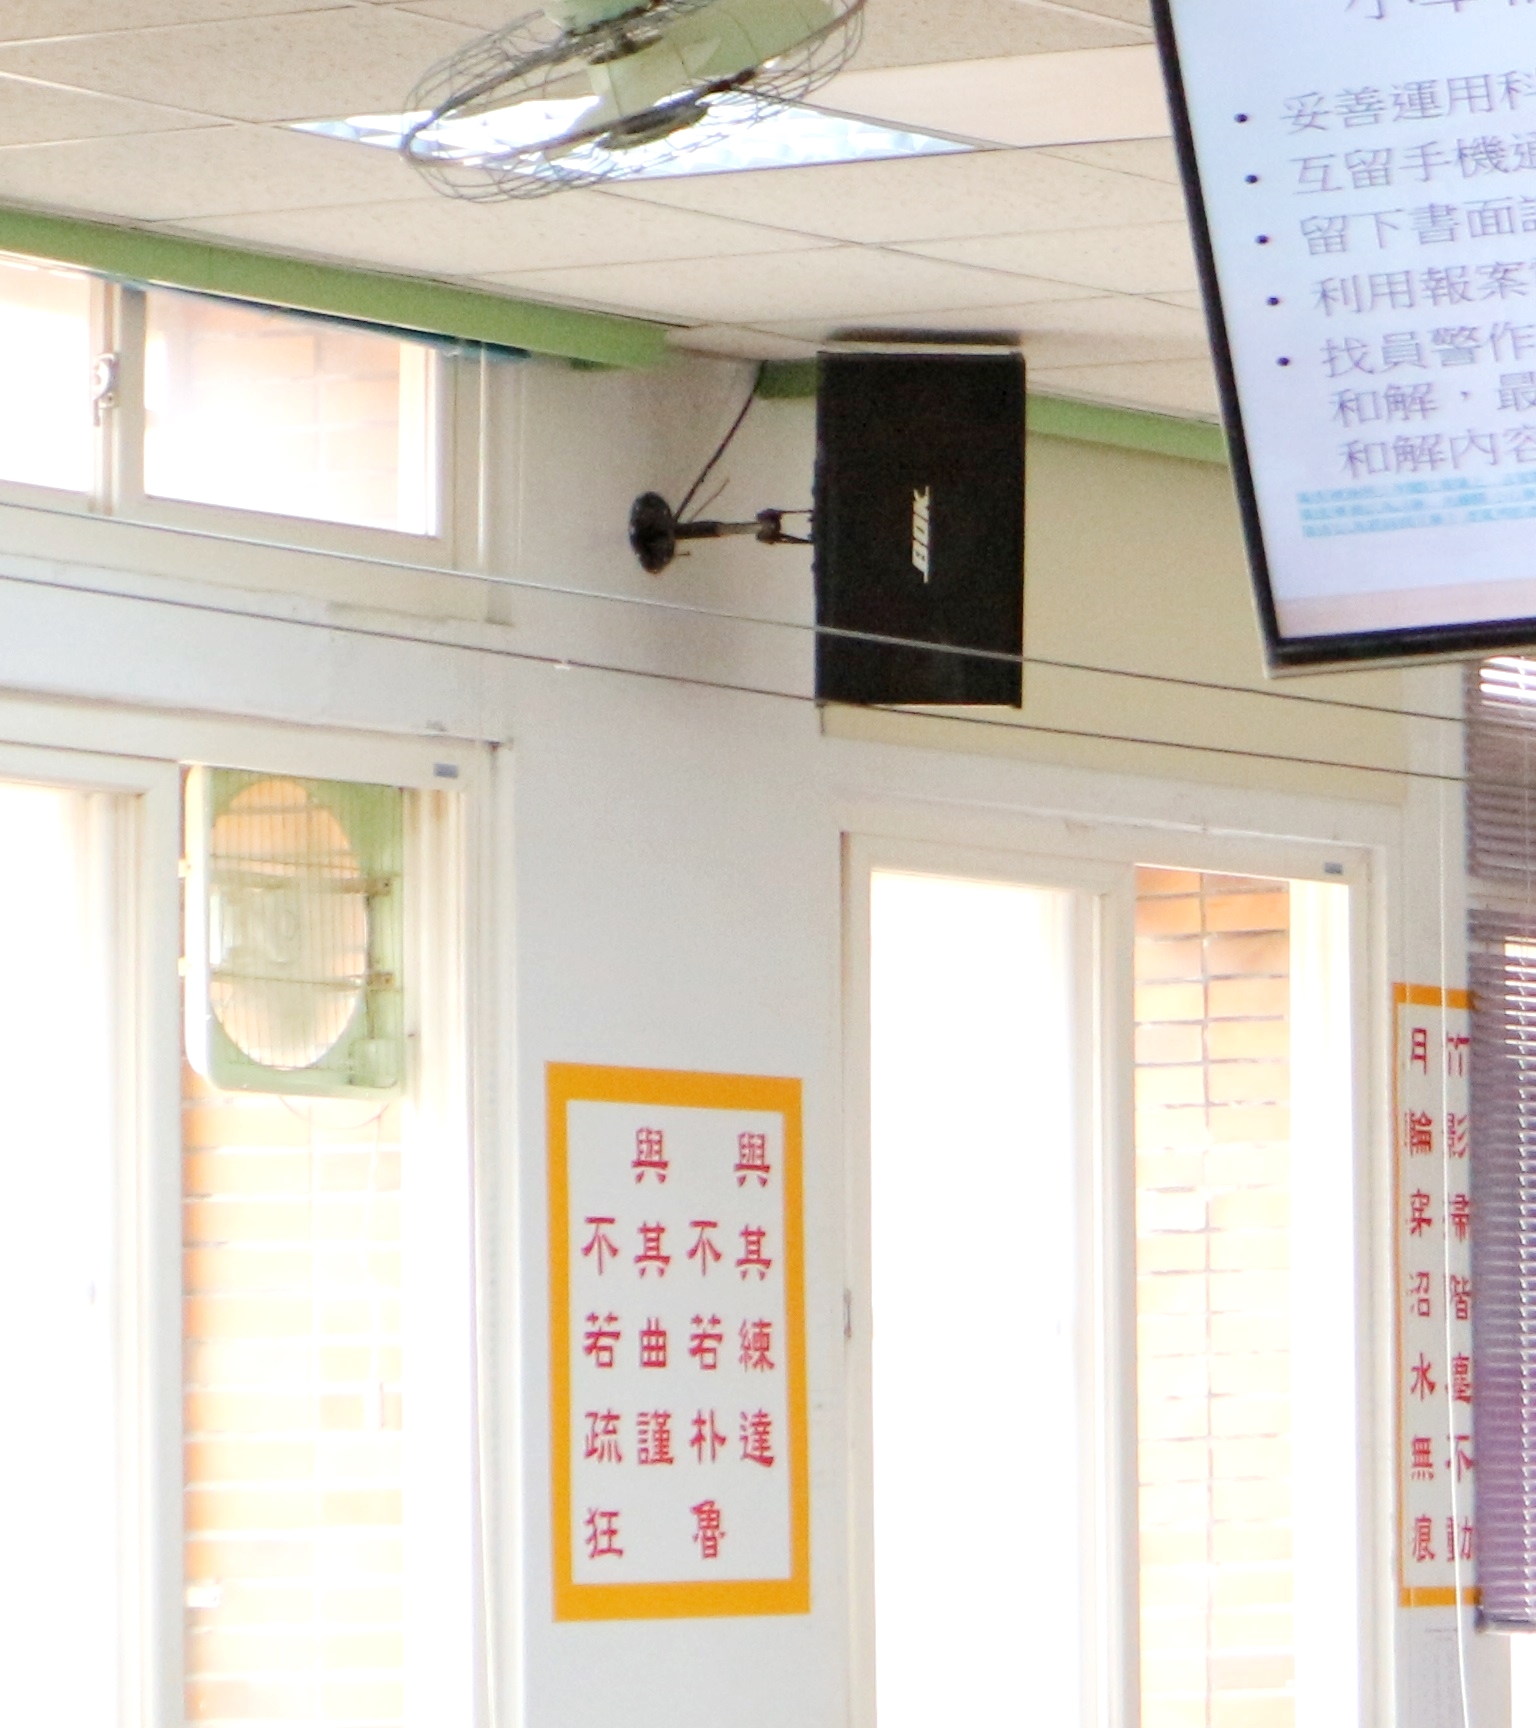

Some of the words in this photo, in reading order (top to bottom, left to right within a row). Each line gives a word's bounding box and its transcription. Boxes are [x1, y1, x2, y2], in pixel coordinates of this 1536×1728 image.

[581, 1215, 624, 1560] 不若疏狂
[734, 1131, 776, 1467] 與其練達
